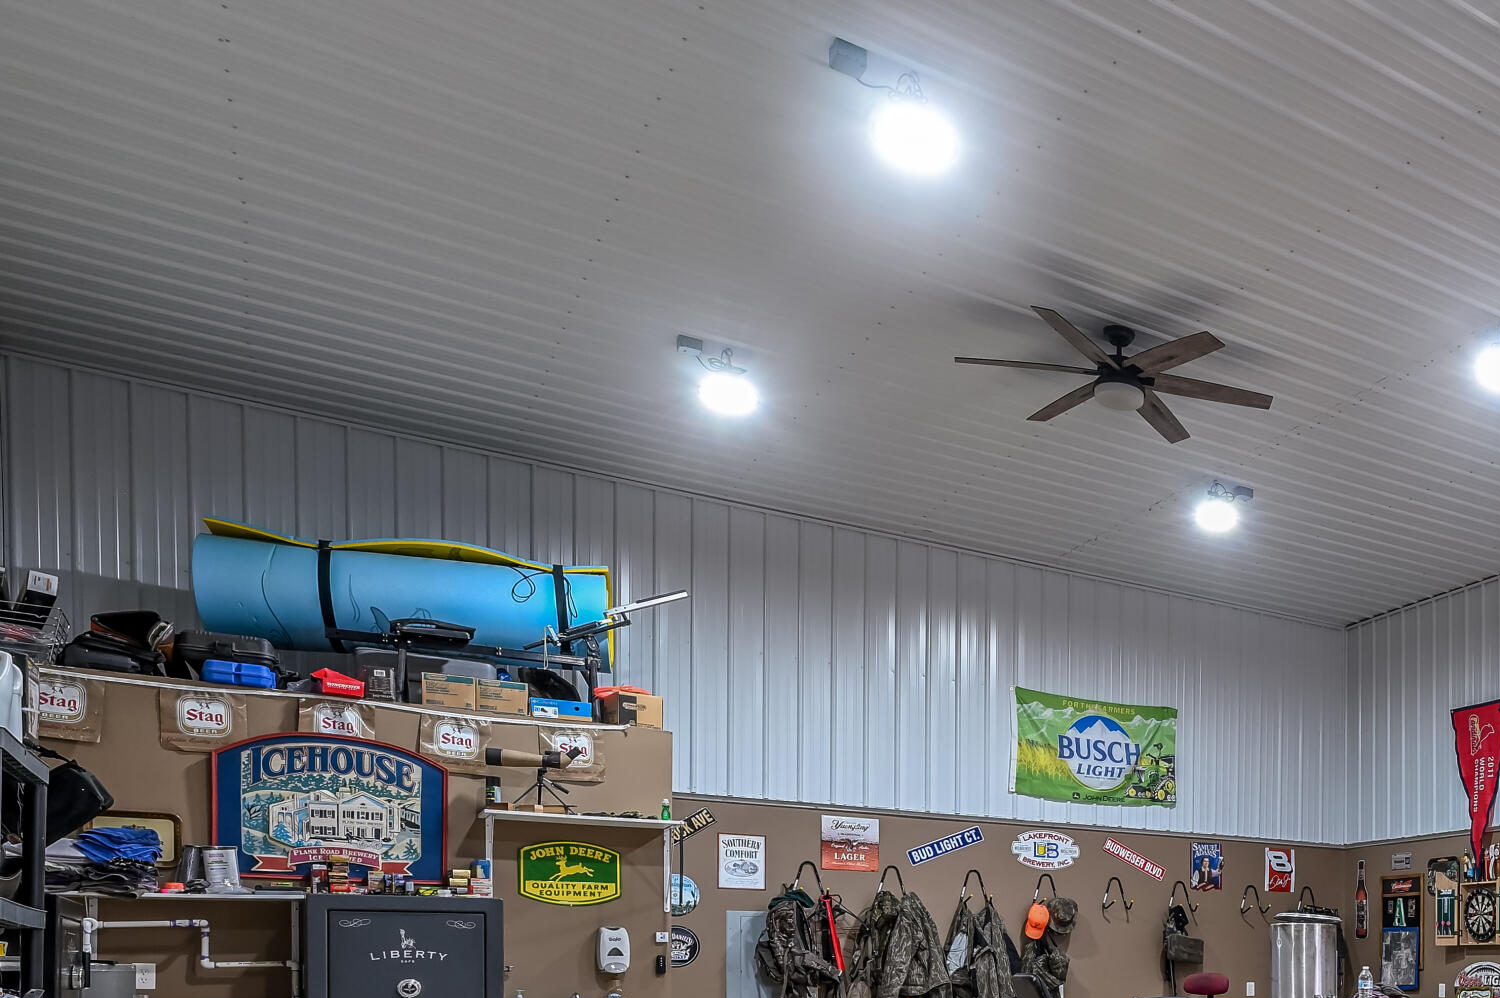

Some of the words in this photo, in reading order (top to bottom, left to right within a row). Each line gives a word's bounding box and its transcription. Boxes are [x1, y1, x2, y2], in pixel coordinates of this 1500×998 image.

[186, 708, 224, 726] Stag
[193, 728, 218, 736] BEER
[322, 716, 355, 734] Stag
[441, 732, 472, 750] Stag
[559, 742, 588, 759] Stg
[1058, 735, 1141, 766] BUSCH
[249, 746, 416, 794] ICEHOUSE
[1076, 763, 1126, 778] LIGHT
[1487, 756, 1495, 778] 2011
[692, 810, 713, 831] AVE
[831, 819, 870, 832] Yuengling
[721, 838, 762, 850] SOUTHERN
[912, 846, 936, 863] BUD
[935, 835, 963, 856] LIGHT
[963, 829, 982, 845] CT.
[1022, 832, 1070, 845] LAKEFRONT
[292, 848, 318, 857] PLANK
[319, 847, 340, 855] ROAD
[342, 849, 379, 860] BREWERY
[725, 849, 759, 859] COMFORT
[1192, 842, 1218, 851] SAMUEL
[530, 846, 565, 861] JOHN
[569, 846, 612, 864] DEERE
[834, 852, 866, 861] LAGER
[1104, 839, 1146, 870] BUDWEISER
[1194, 850, 1217, 859] ADAMS
[1267, 850, 1293, 873] 8
[531, 882, 577, 891] QUALITY
[581, 883, 609, 891] FARM
[539, 889, 603, 898] EQUIPMENT
[370, 950, 449, 962] LIBERTY
